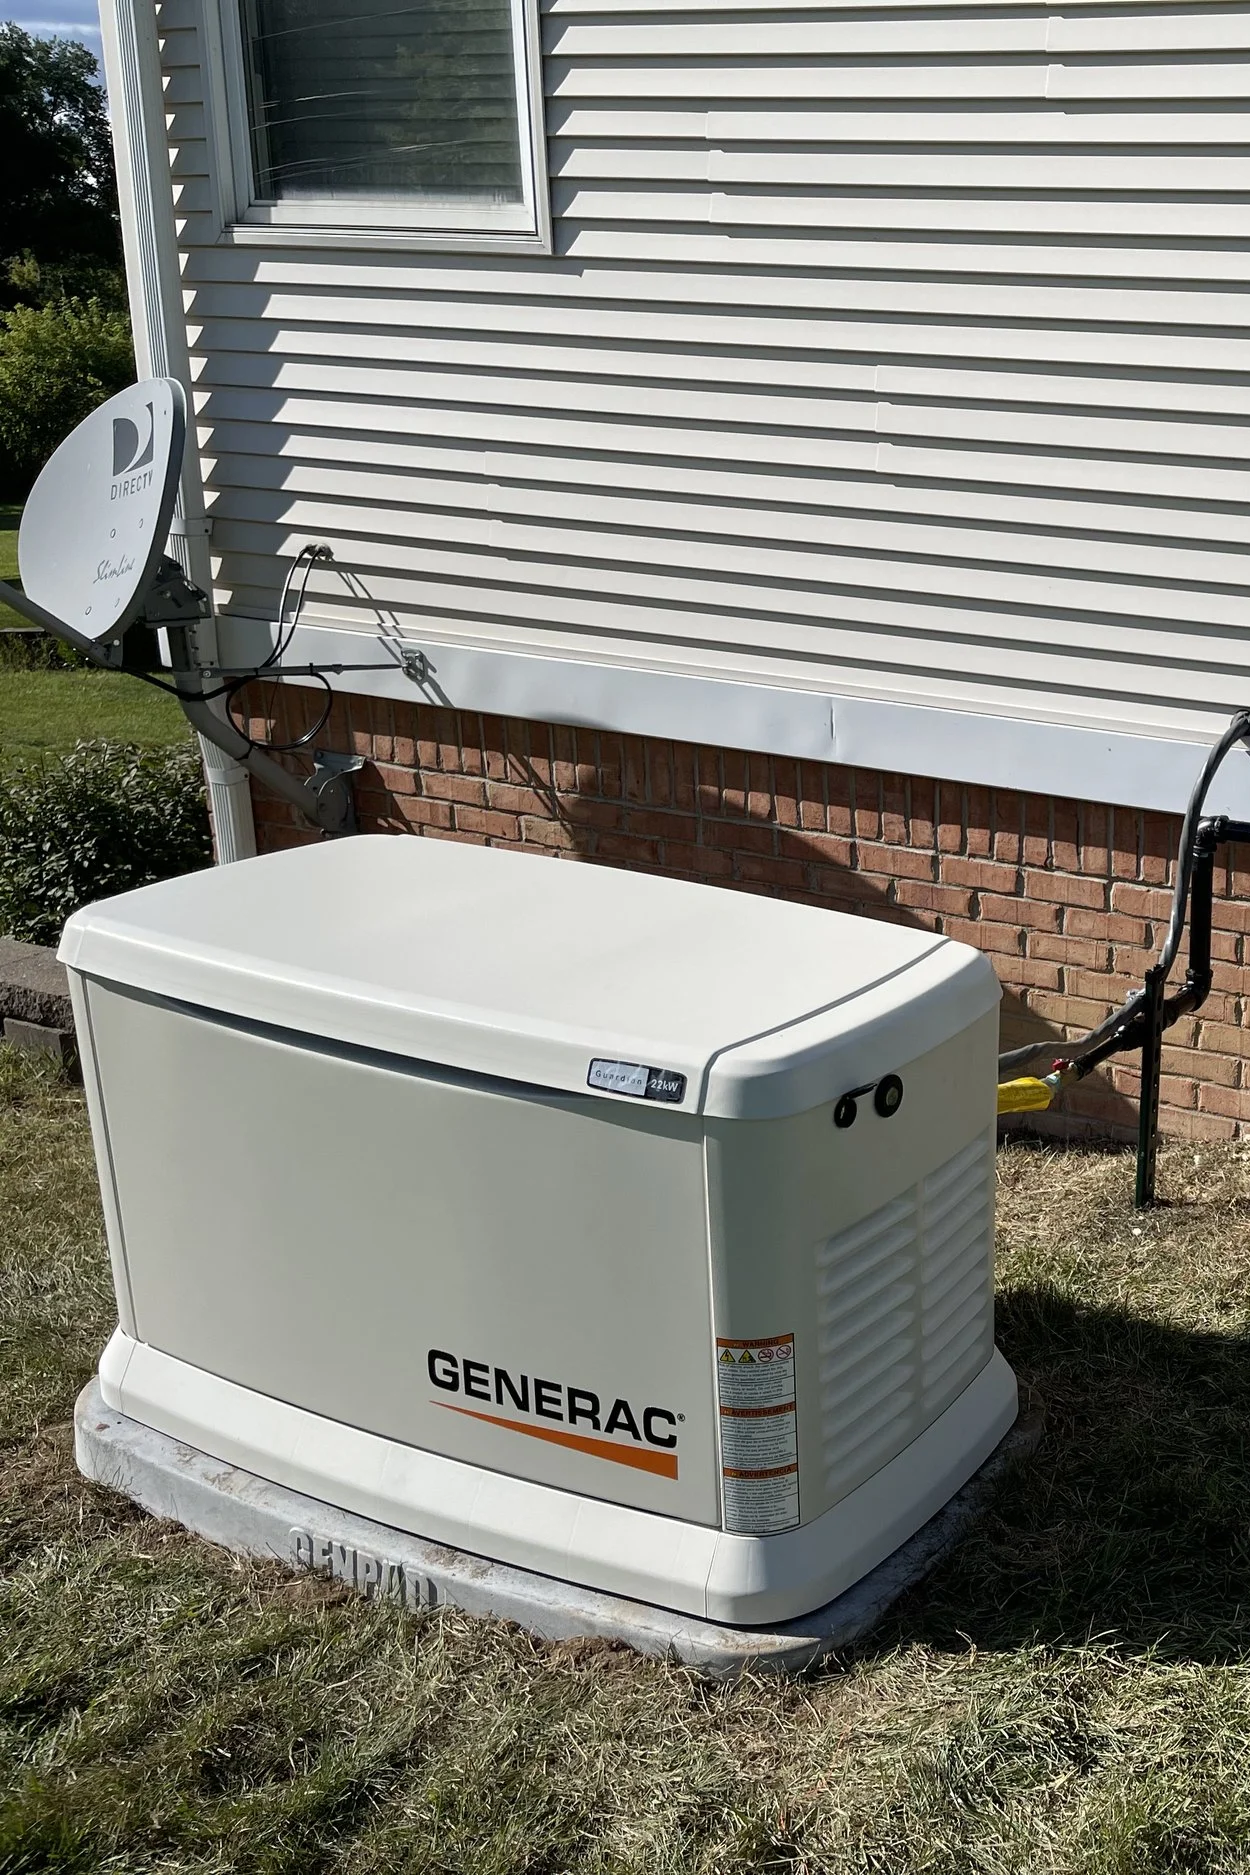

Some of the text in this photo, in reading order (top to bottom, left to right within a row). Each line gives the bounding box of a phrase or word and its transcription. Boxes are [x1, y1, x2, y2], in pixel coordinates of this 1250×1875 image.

[110, 470, 153, 500] DIRECTV
[595, 1069, 679, 1092] Guardian 22kW
[742, 1339, 779, 1348] WARNING
